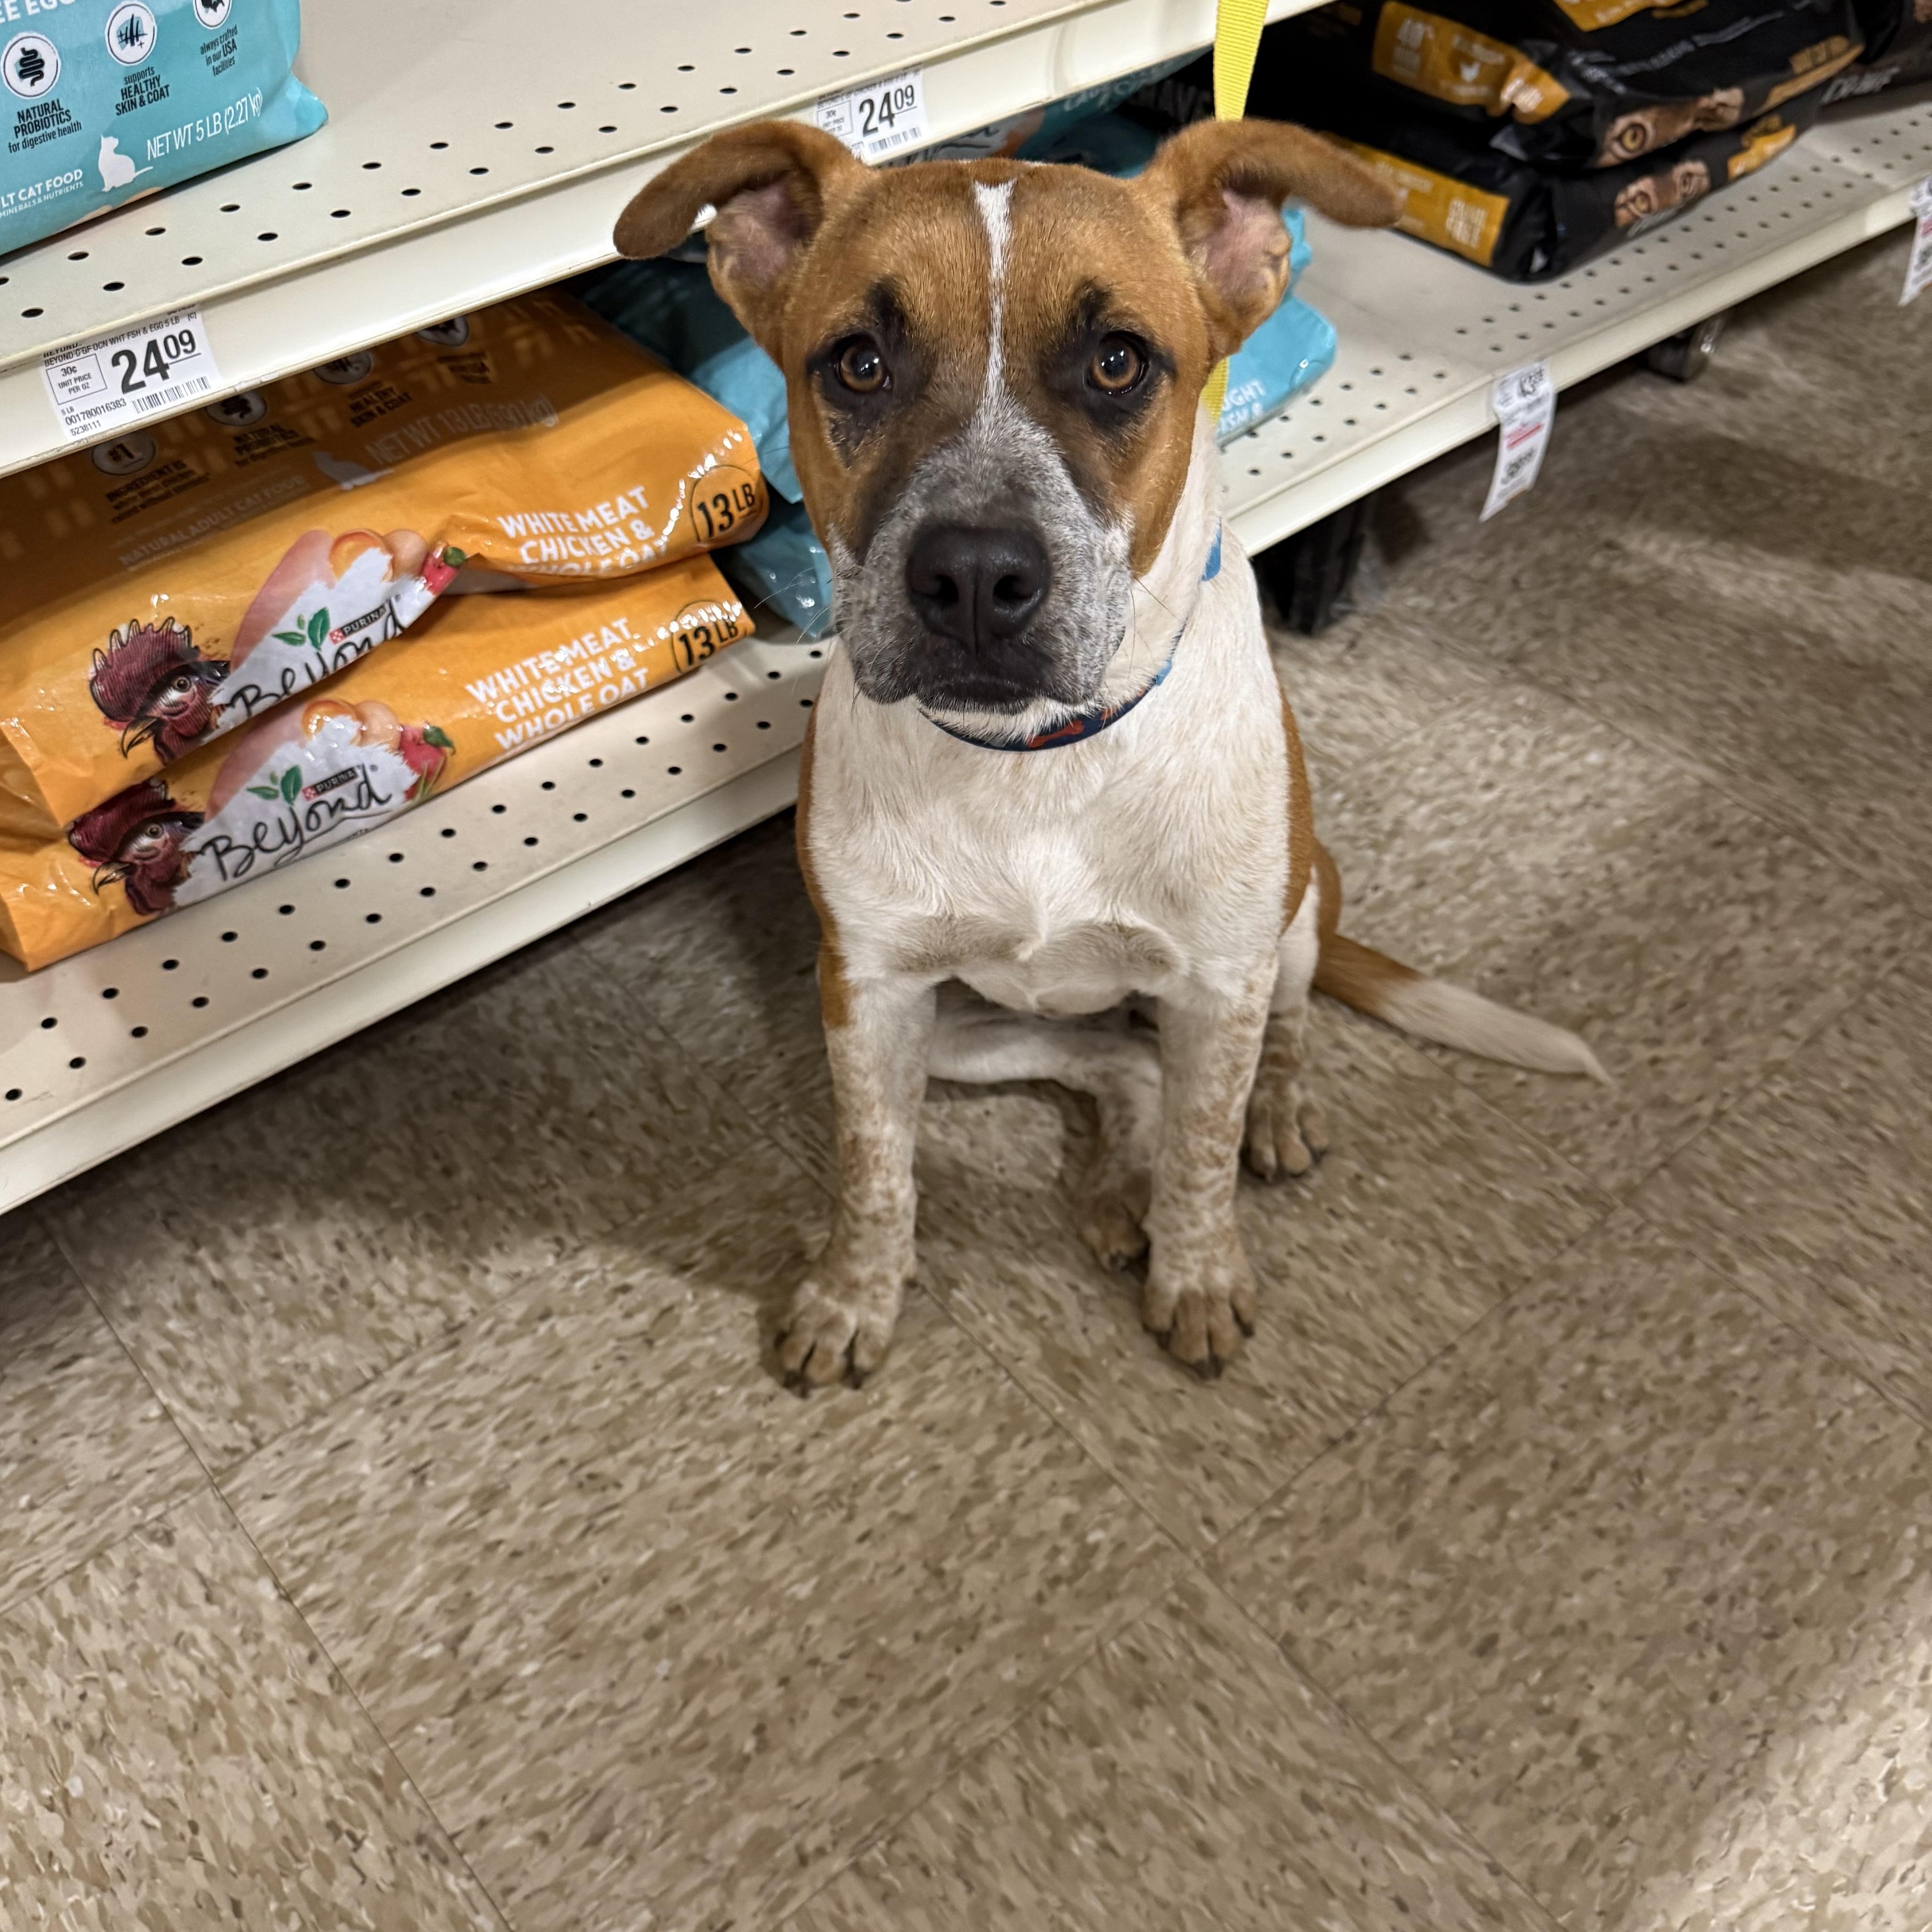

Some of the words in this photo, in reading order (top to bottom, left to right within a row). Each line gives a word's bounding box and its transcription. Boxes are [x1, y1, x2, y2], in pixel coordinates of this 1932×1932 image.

[25, 0, 75, 16] EG
[205, 55, 212, 66] in
[213, 50, 222, 62] our
[222, 38, 237, 57] USA
[213, 56, 235, 77] facilities
[121, 74, 160, 101] HEALTHY
[124, 66, 155, 85] supports
[17, 99, 64, 124] NATURAL
[115, 97, 138, 116] SKIN
[139, 95, 146, 107] &
[147, 84, 170, 104] COAT
[8, 141, 20, 153] for
[22, 129, 56, 149] digestive
[57, 120, 82, 138] health
[14, 109, 72, 139] PROBIOTICS
[147, 131, 171, 161] NET
[173, 122, 194, 150] WT
[196, 119, 204, 141] 5
[206, 112, 222, 138] LB
[224, 96, 248, 135] (2.27
[248, 87, 263, 117] kg)
[18, 186, 43, 201] CAT
[46, 169, 83, 192] FOOD
[44, 181, 83, 201] NUTRIENTS
[44, 351, 74, 367] BEYOND
[93, 340, 108, 351] OCN
[109, 334, 125, 345] WHT
[58, 378, 73, 389] UNIT
[74, 372, 92, 384] PRICE
[61, 366, 77, 377] 30¢
[82, 382, 91, 390] OZ
[108, 444, 134, 462] #1
[365, 431, 412, 466] NET
[402, 416, 441, 449] WT
[105, 465, 174, 502] INGREDIENT
[188, 505, 235, 537] ADULT
[498, 513, 578, 539] WHITE
[573, 486, 648, 533] MEAT
[698, 494, 734, 538] 13
[732, 483, 755, 513] LB
[519, 527, 631, 564] CHICKEN
[629, 519, 655, 540] &
[342, 606, 387, 635] PURINA
[225, 595, 407, 716] Beyond
[465, 651, 560, 703] WHITE
[558, 618, 632, 666] MEAT
[679, 626, 715, 666] 13
[495, 657, 613, 718] CHICKEN
[616, 651, 637, 672] &
[494, 693, 595, 750] WHOLE
[599, 668, 649, 705] OAT
[199, 763, 392, 881] Beyond
